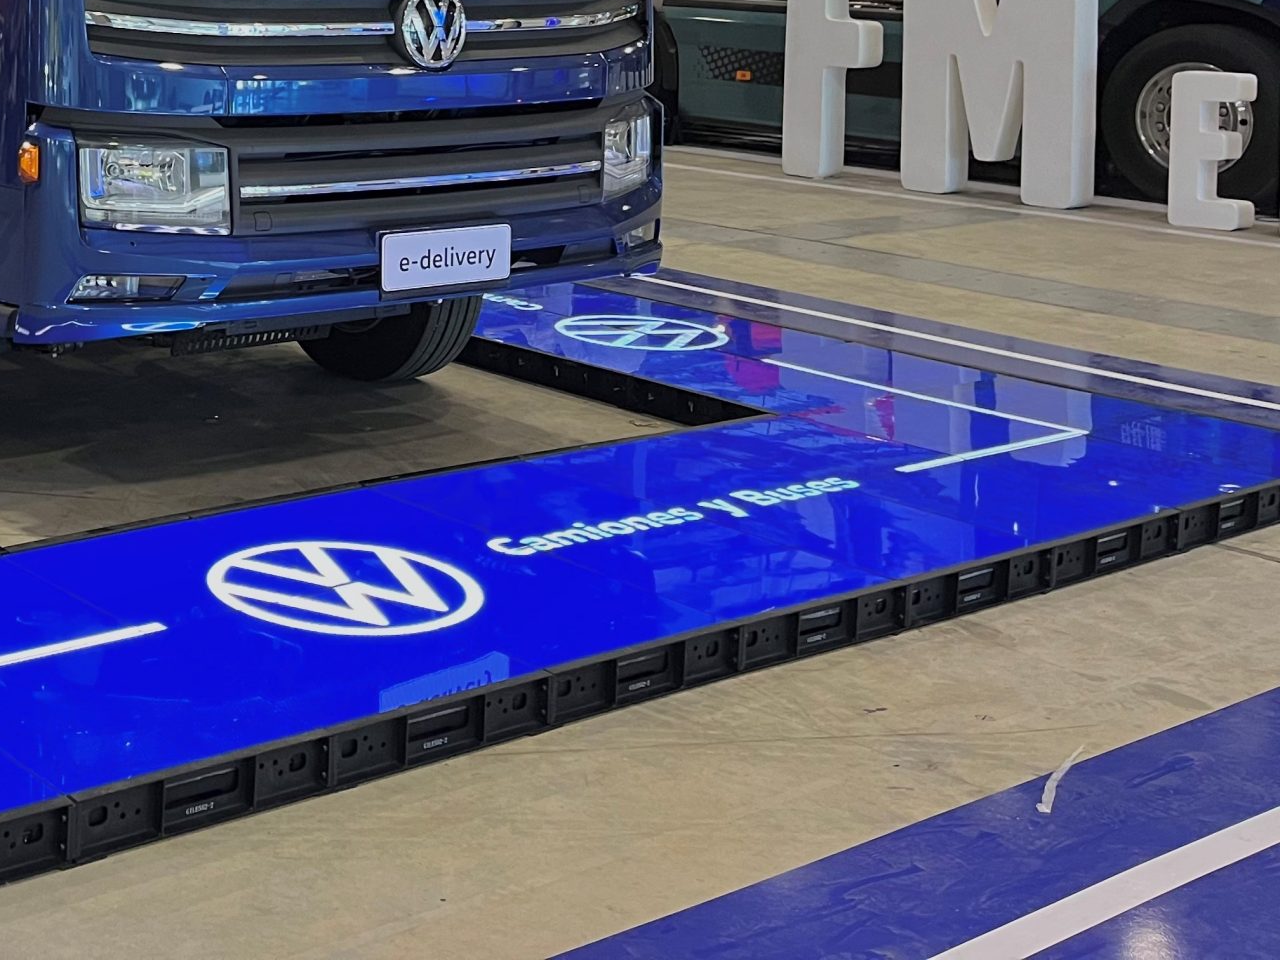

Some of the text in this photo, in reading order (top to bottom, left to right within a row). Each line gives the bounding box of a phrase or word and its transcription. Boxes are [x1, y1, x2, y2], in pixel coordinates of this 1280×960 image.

[399, 246, 497, 272] e-delivery
[486, 474, 860, 557] Camiones y Buses
